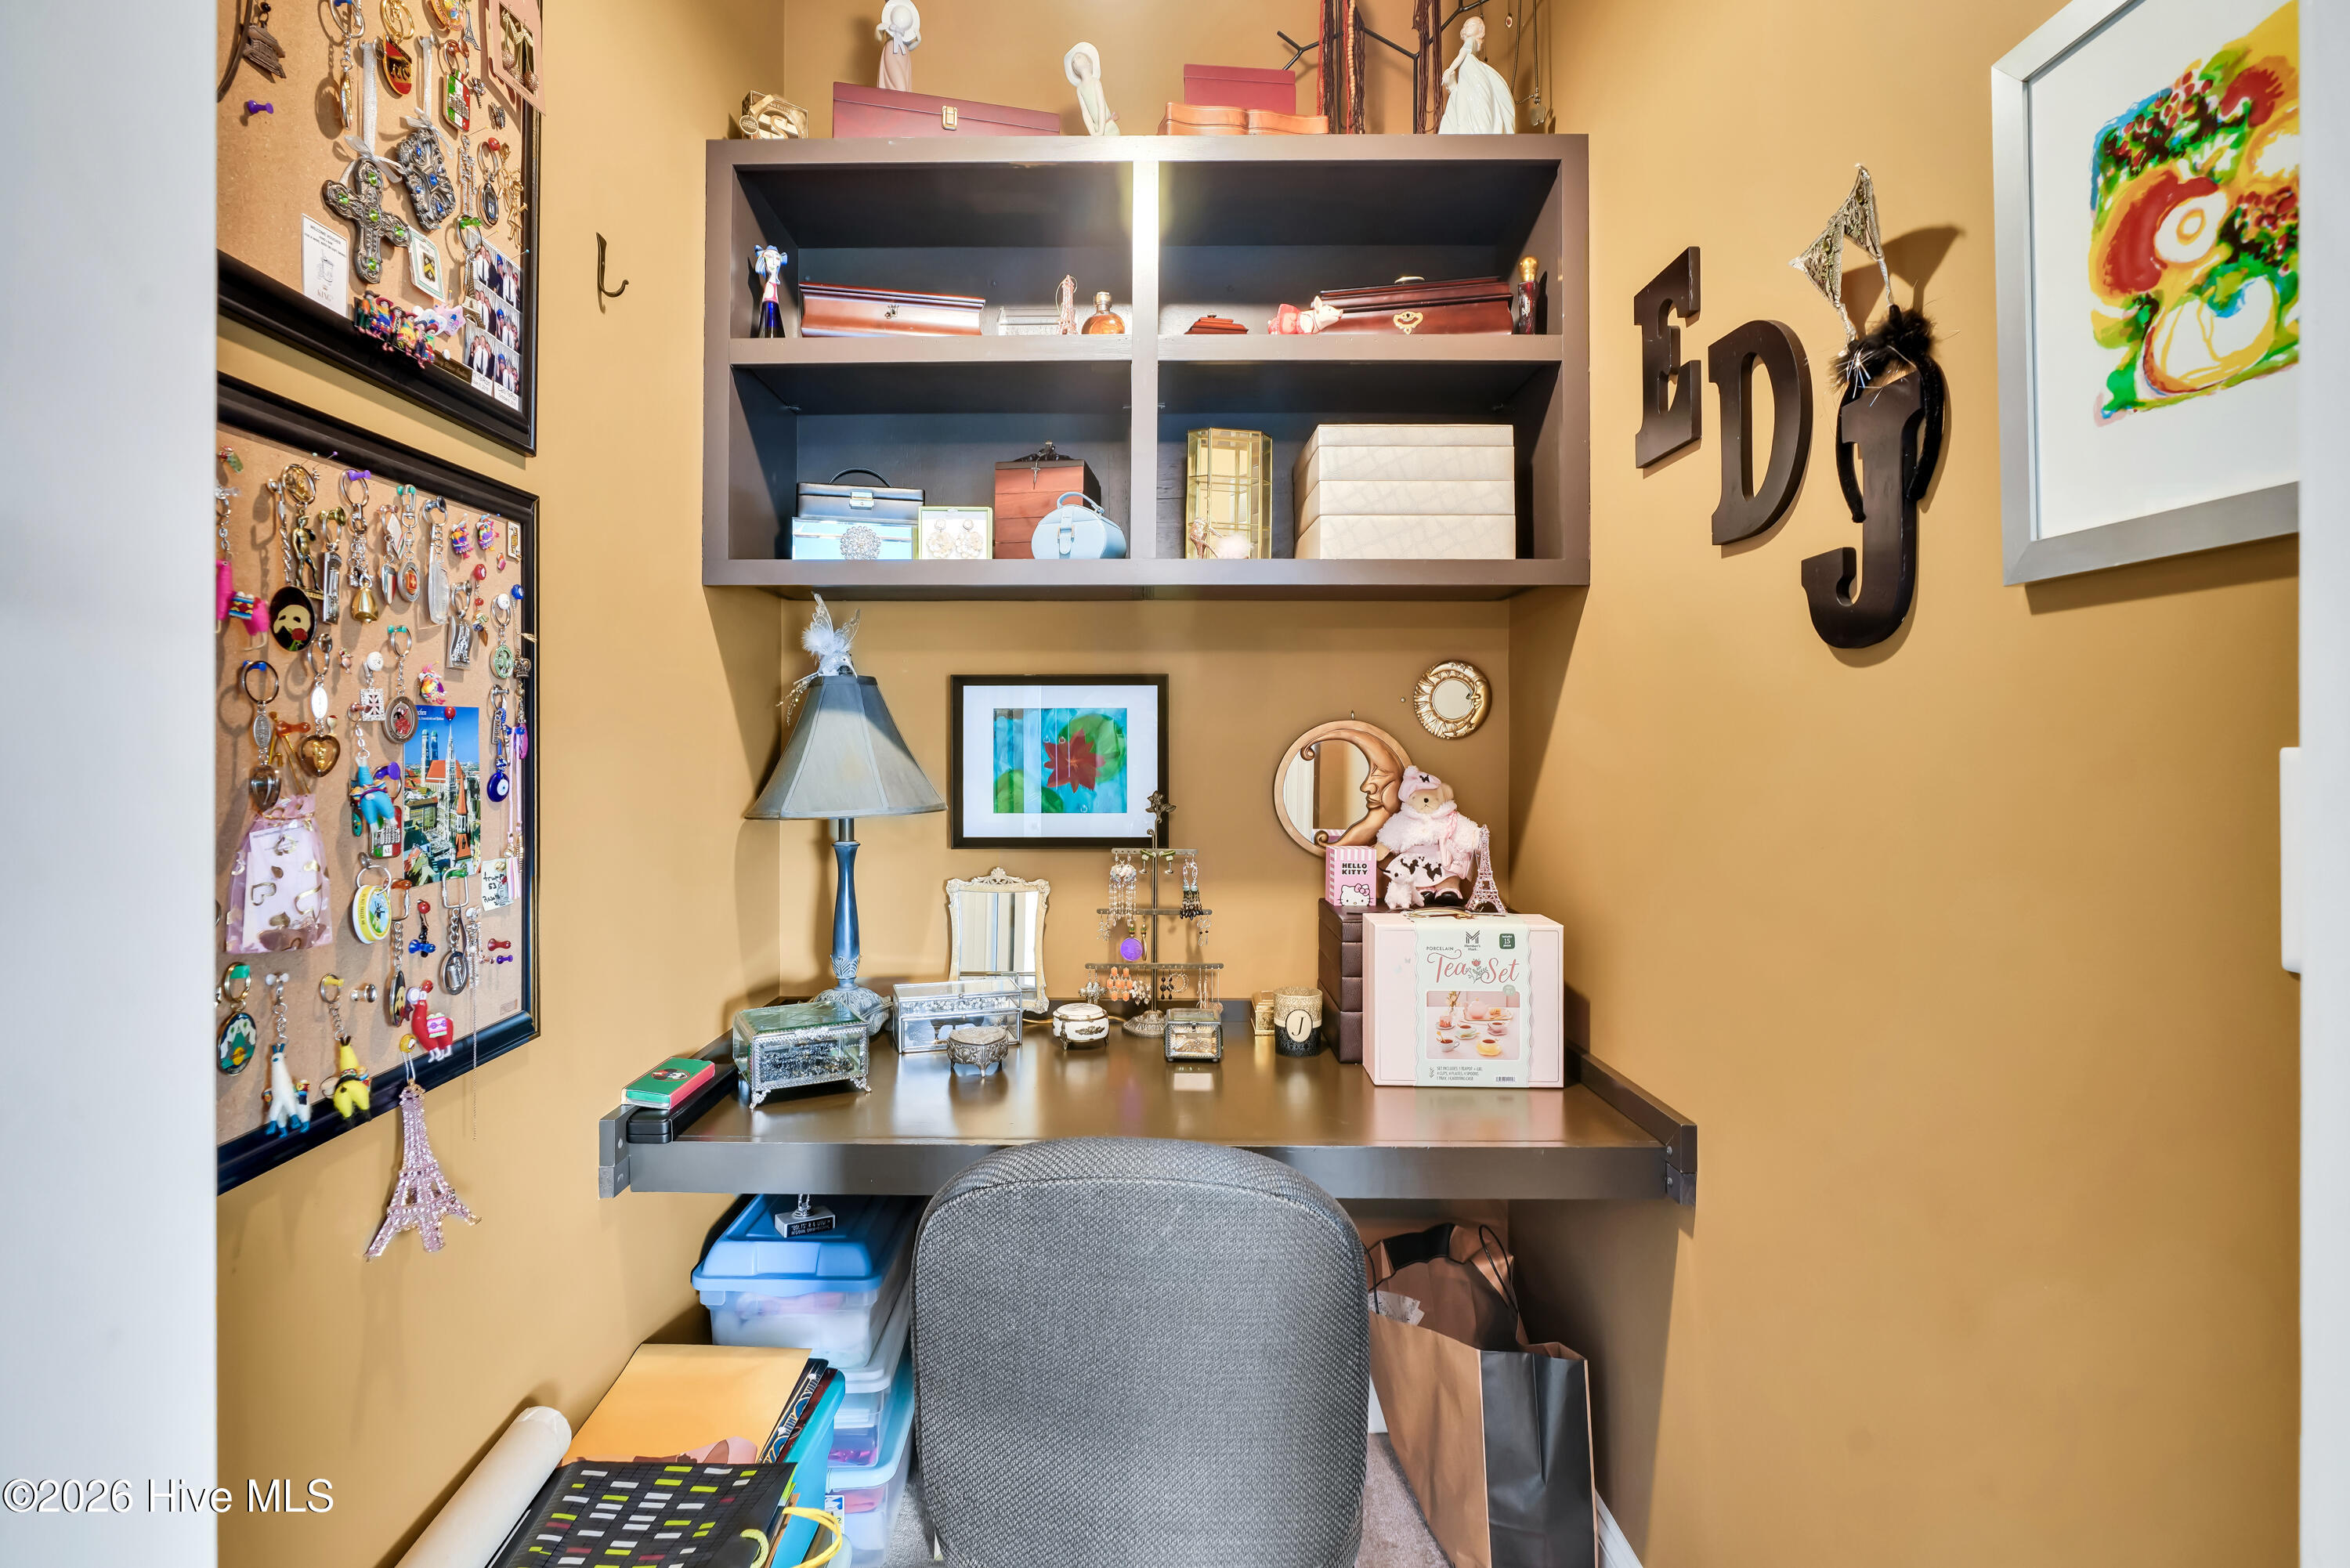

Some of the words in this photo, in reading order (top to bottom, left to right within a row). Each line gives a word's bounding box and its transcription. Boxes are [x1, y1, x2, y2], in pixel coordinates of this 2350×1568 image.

[1427, 949, 1469, 983] Tea
[1480, 957, 1520, 985] Set
[1291, 1016, 1307, 1036] J
